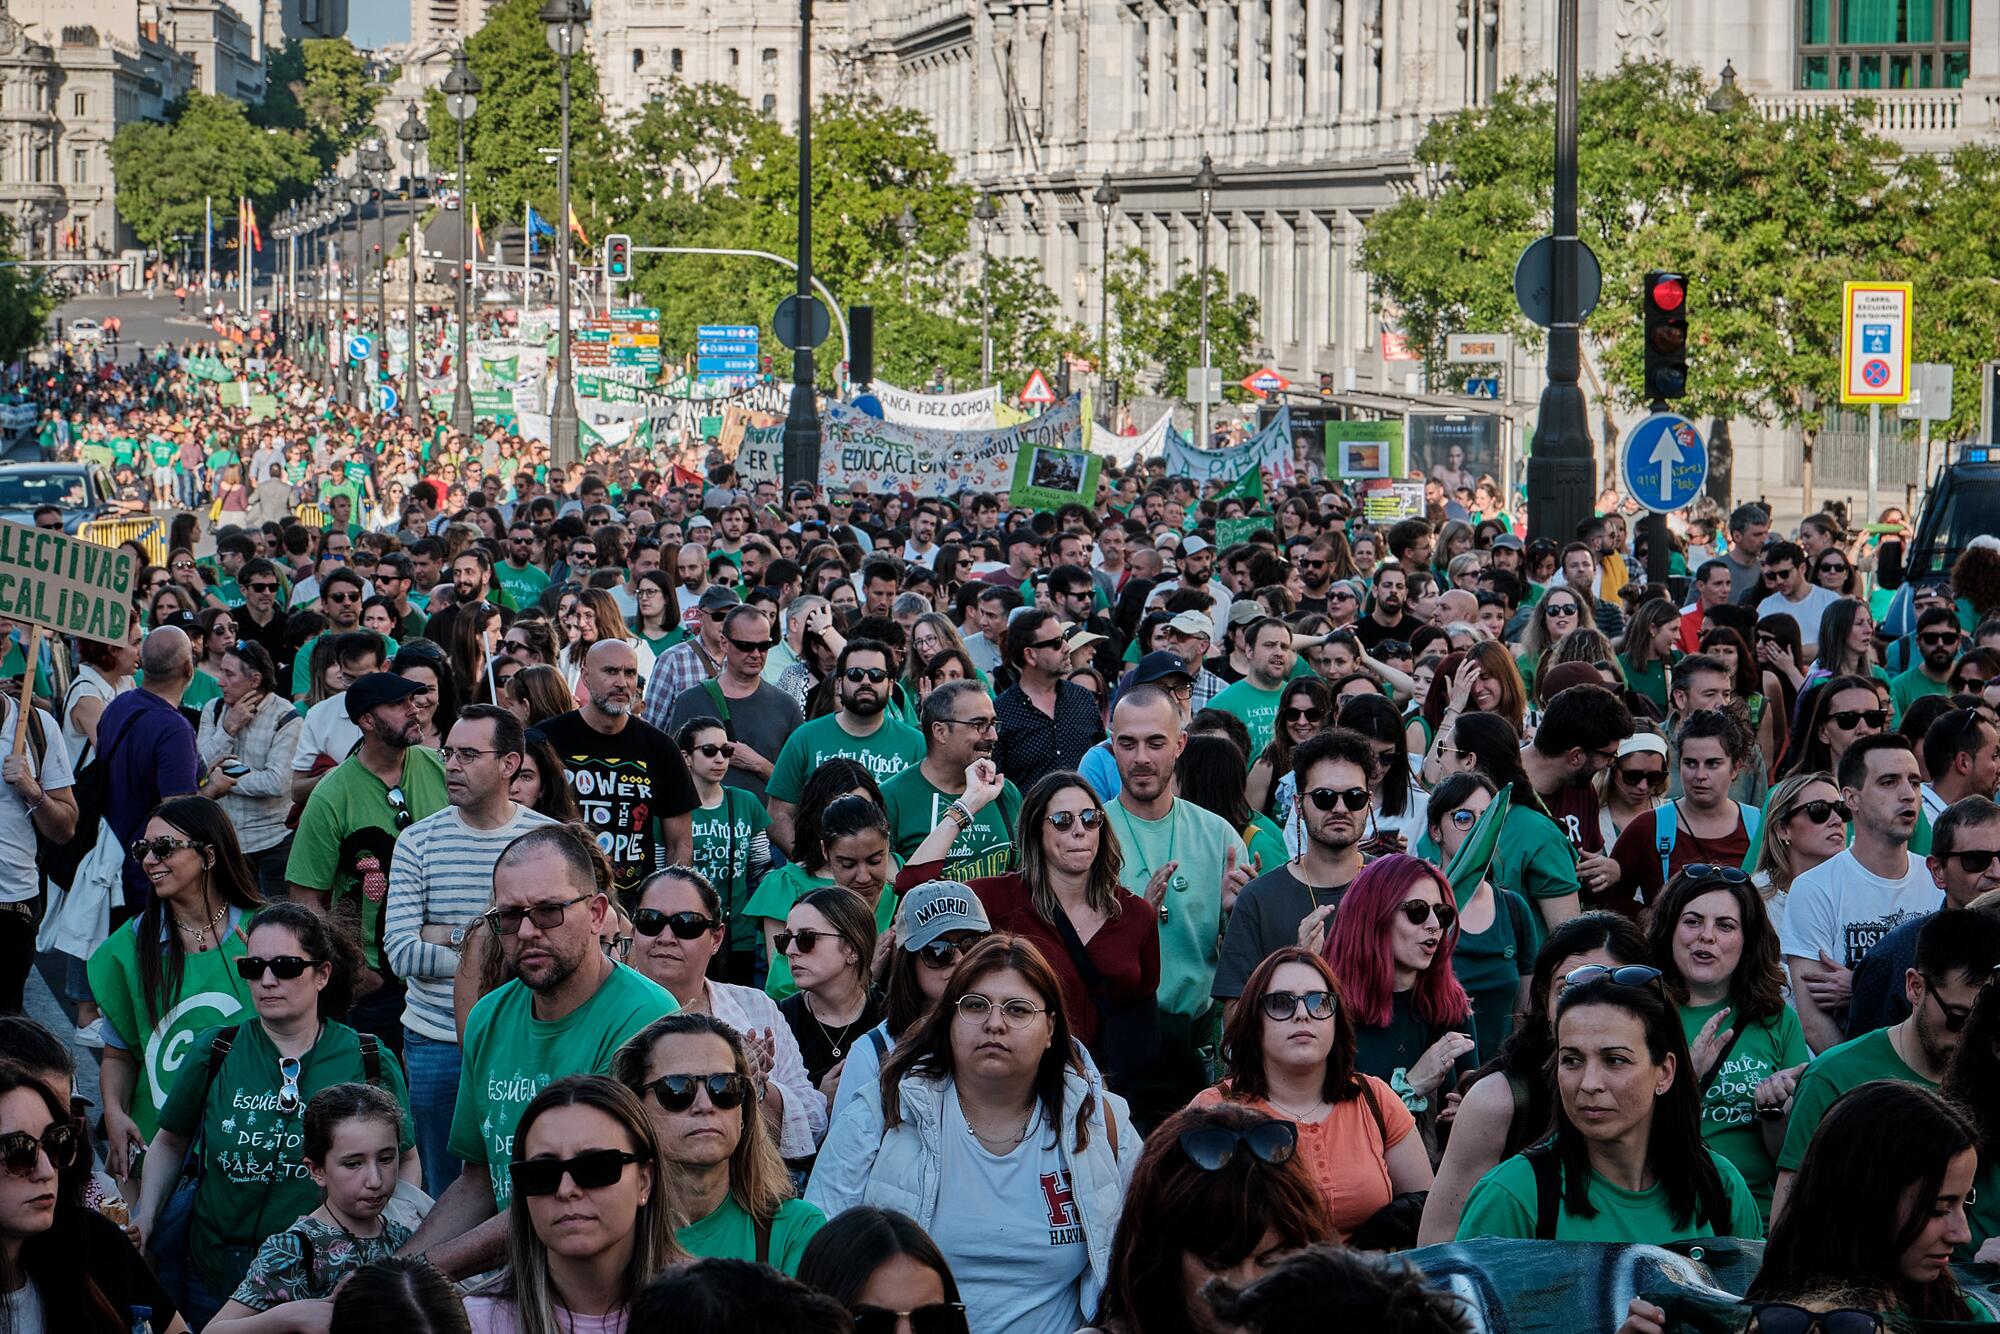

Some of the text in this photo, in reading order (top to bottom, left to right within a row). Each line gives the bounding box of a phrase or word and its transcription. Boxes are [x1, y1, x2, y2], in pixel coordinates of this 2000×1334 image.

[882, 391, 911, 412] ANCA
[951, 399, 992, 417] OCHOA
[0, 525, 131, 594] LECTiVAS
[579, 799, 631, 827] TO THE
[594, 830, 644, 862] OPLE
[916, 897, 968, 926] MADRID
[1849, 931, 1877, 948] LOS
[1705, 1082, 1758, 1099] OD@S
[233, 1094, 282, 1111] ESCUEL
[237, 1130, 265, 1147] DE
[496, 1134, 514, 1156] DE
[1049, 1226, 1087, 1246] HARVA
